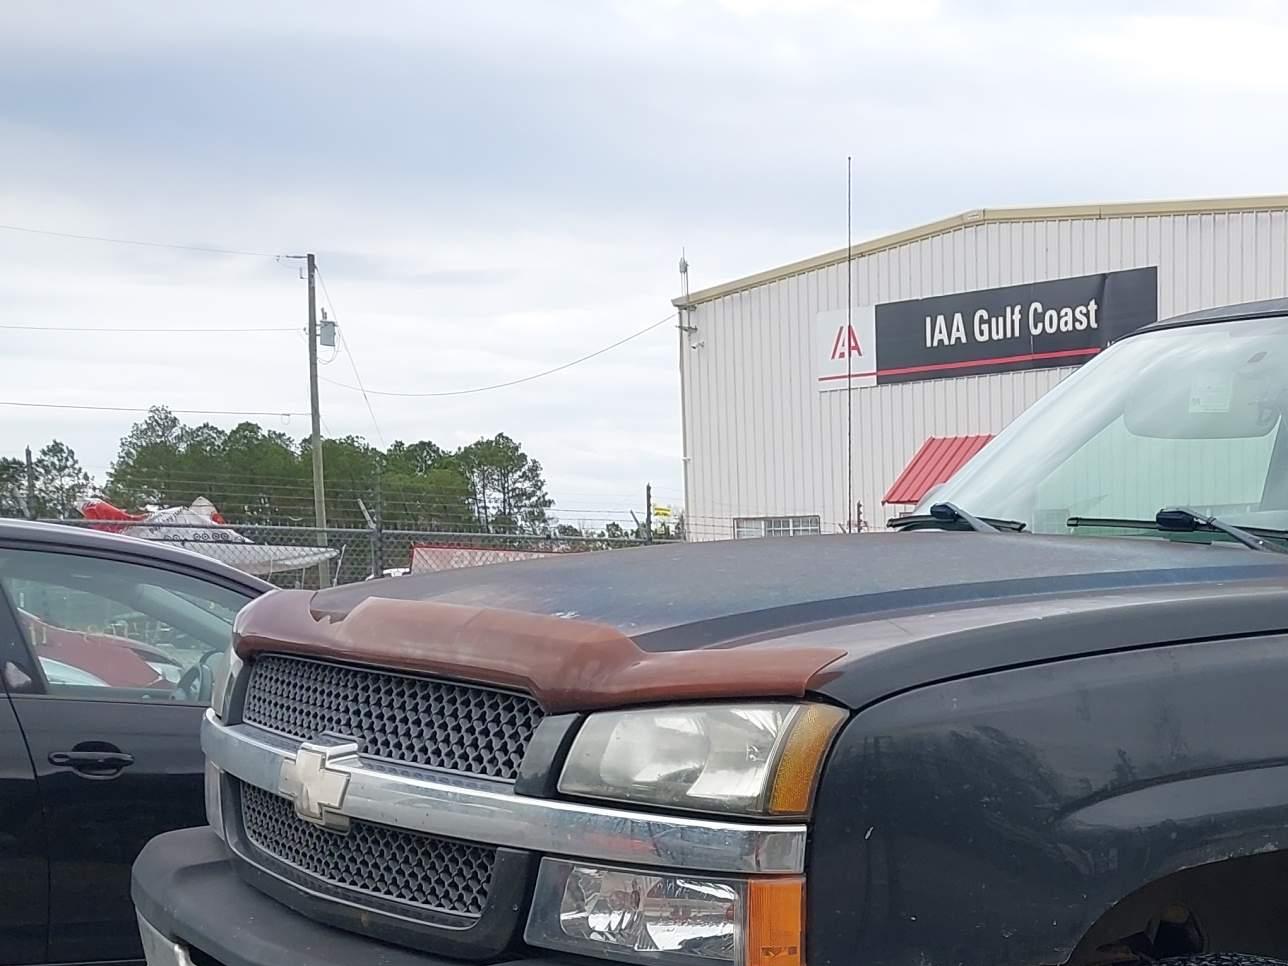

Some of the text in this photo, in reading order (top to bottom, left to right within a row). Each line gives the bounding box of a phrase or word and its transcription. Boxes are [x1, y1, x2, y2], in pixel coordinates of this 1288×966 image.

[924, 298, 1099, 348] IAA Gulf Coast
